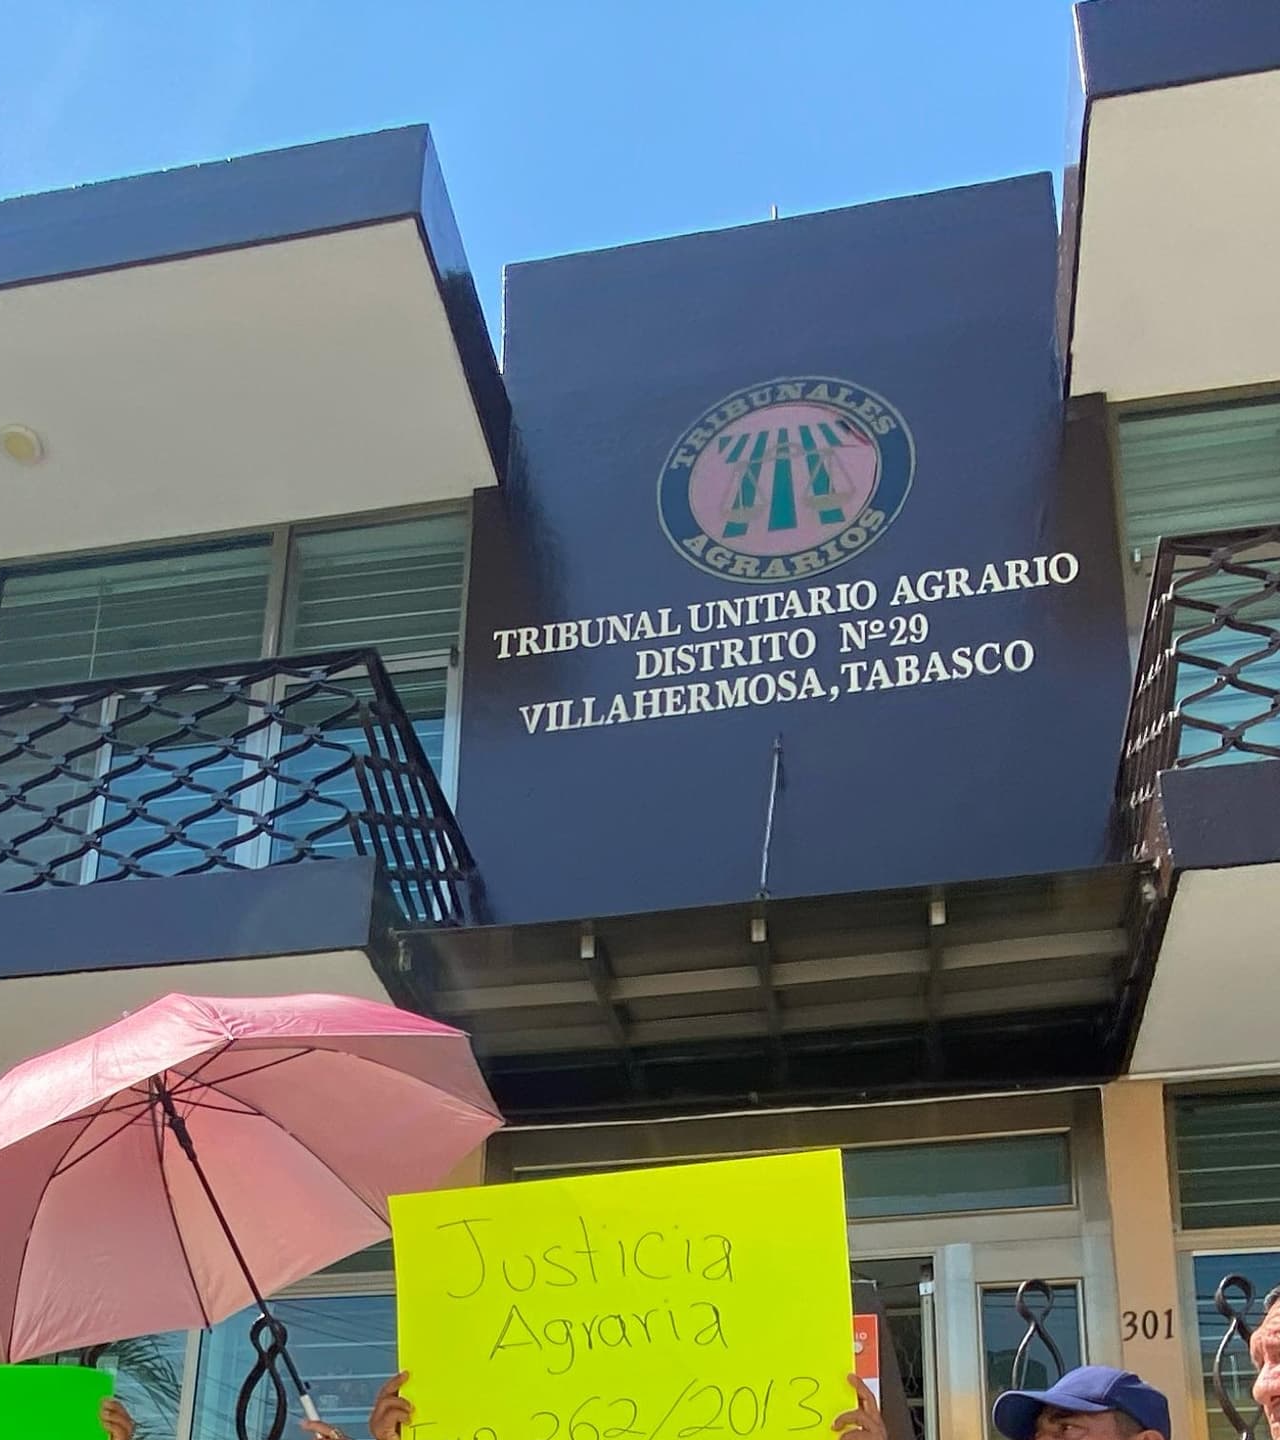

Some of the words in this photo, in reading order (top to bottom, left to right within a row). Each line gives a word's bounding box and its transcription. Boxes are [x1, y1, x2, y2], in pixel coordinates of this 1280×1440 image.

[670, 383, 896, 470] TRIBUNALES
[682, 508, 886, 578] AGRARIOS
[493, 608, 681, 660] TRIBUNAL
[687, 580, 877, 633] UNITARIO
[890, 552, 1080, 606] AGRARIO
[635, 629, 816, 680] DISTRITO
[841, 639, 1035, 693] TABASCO
[436, 1216, 735, 1299] Justicia
[489, 1299, 729, 1375] Agraria
[1122, 1308, 1174, 1341] 301
